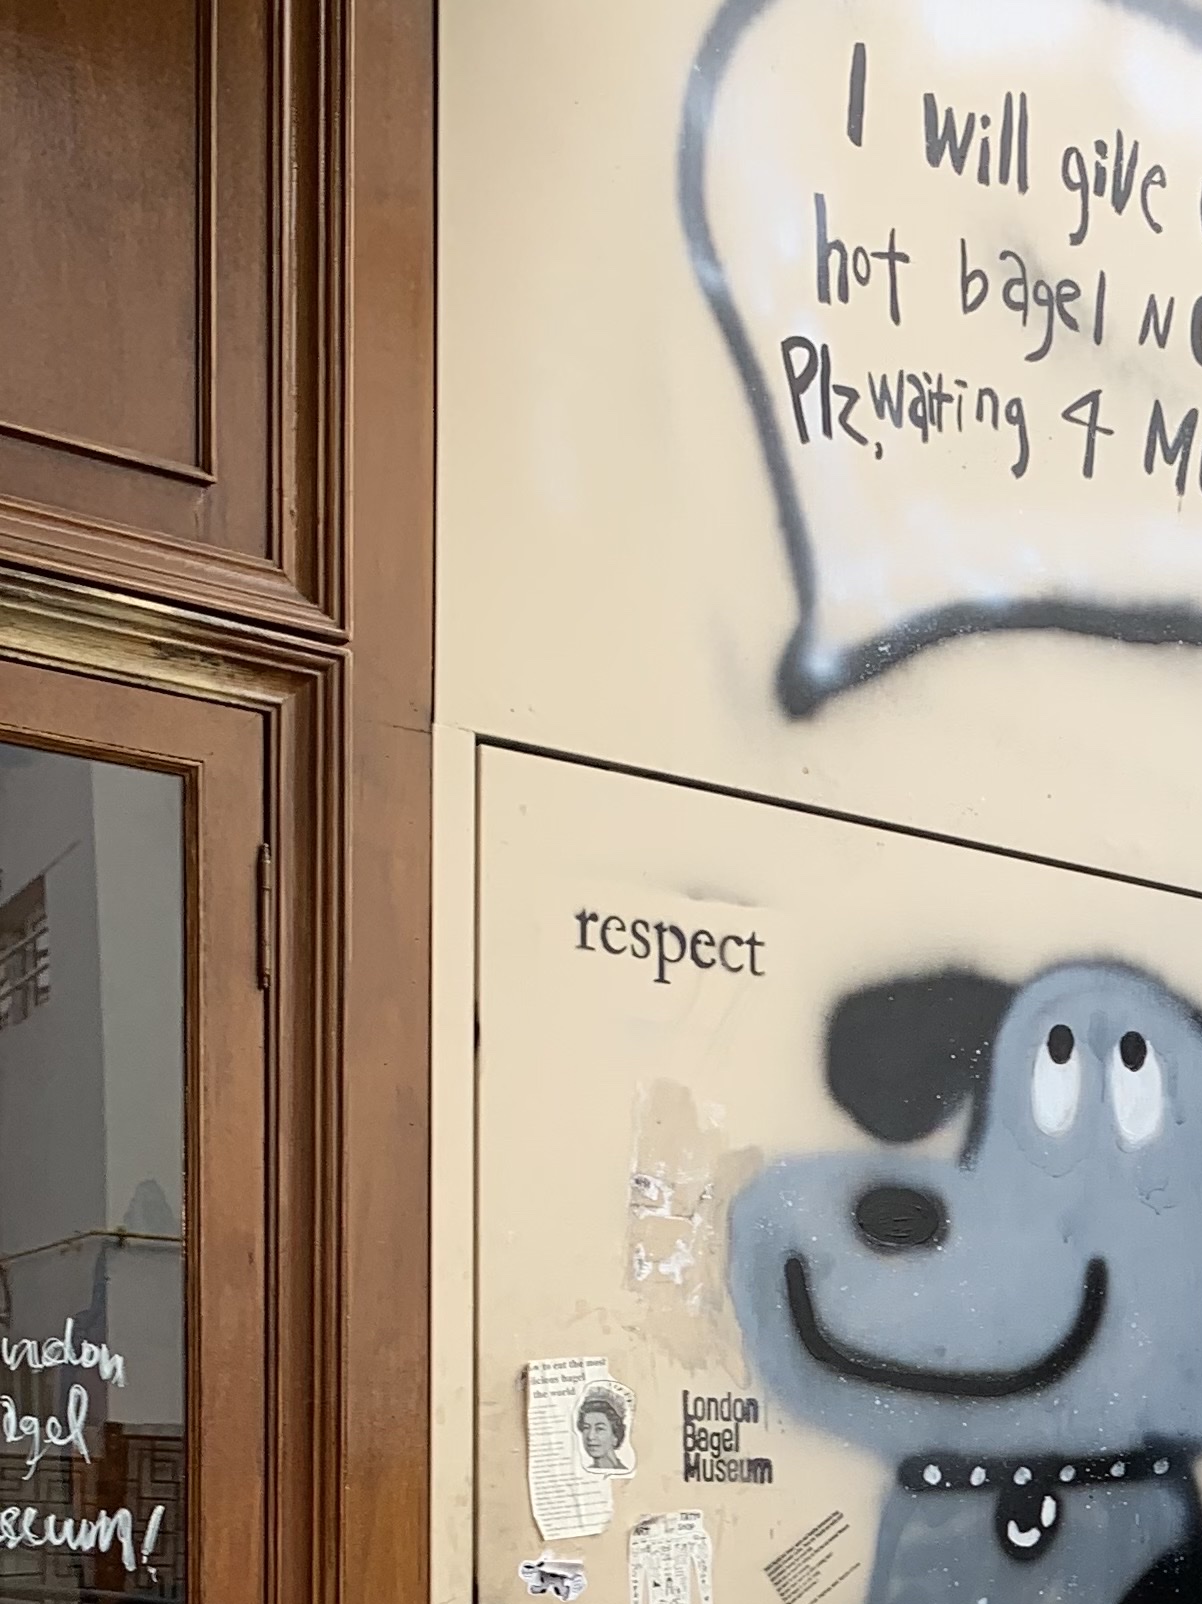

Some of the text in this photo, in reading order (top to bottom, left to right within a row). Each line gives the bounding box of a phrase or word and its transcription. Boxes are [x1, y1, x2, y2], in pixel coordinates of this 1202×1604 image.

[846, 42, 867, 147] I
[813, 192, 910, 327] hot
[960, 237, 1107, 363] bagel
[1061, 388, 1115, 480] 4
[574, 907, 766, 985] respect
[682, 1389, 760, 1424] London
[682, 1421, 740, 1459] Bagel
[683, 1451, 773, 1485] Museum
